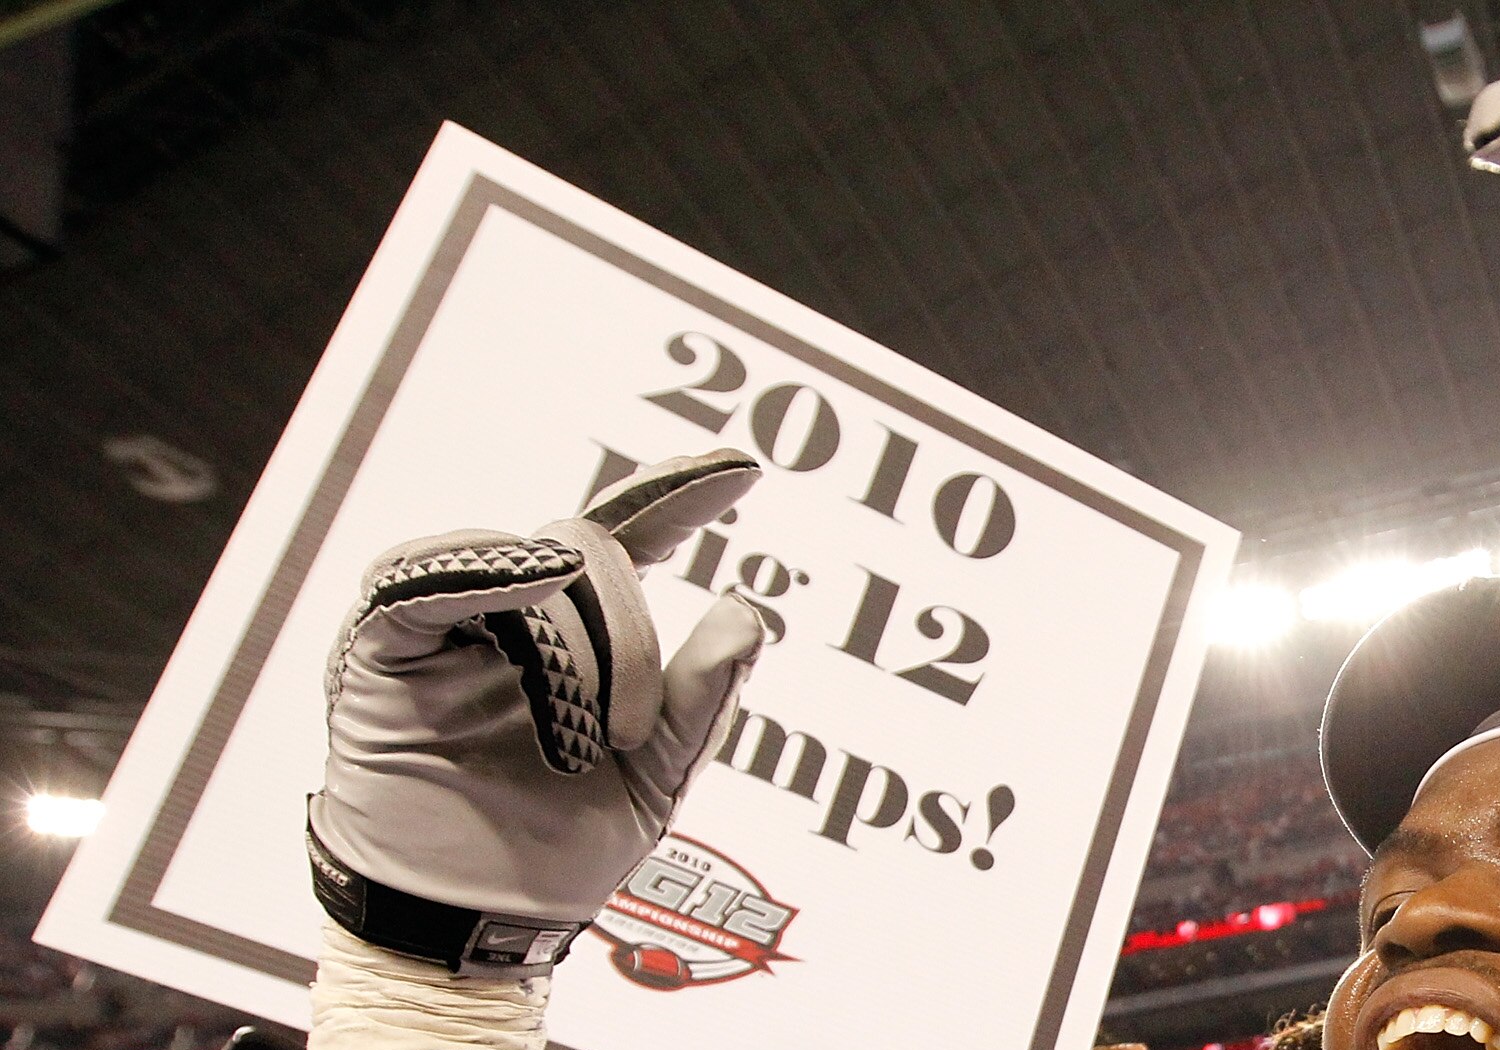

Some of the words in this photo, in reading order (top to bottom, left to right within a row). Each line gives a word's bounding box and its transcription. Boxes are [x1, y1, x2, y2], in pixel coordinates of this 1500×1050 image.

[638, 331, 1017, 560] 2010
[824, 563, 992, 708] 12
[716, 707, 1016, 872] mps!
[610, 893, 741, 950] AMPIONSHIP
